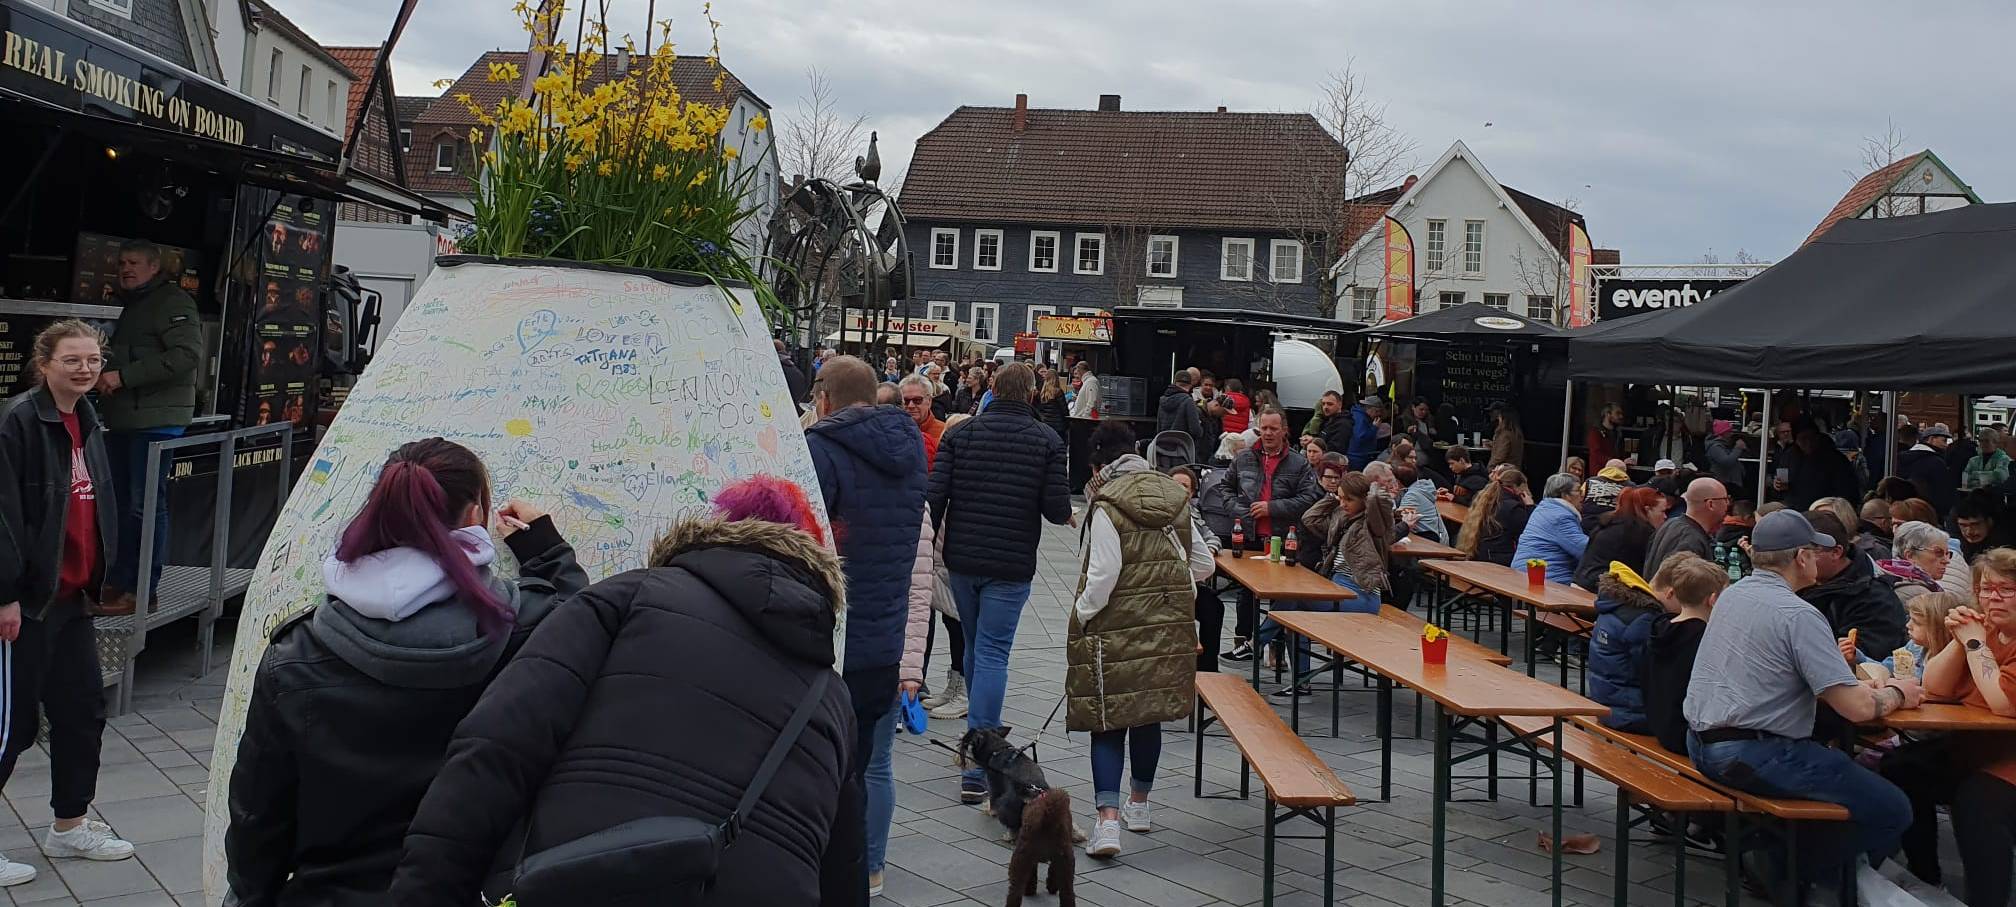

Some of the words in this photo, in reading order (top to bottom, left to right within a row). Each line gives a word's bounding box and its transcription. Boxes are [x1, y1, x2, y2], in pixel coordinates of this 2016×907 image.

[2, 31, 67, 85] REAL
[74, 59, 164, 118] SMOKING
[168, 96, 191, 128] ON
[194, 105, 244, 145] BOARD
[884, 320, 938, 332] wster
[1056, 323, 1081, 334] ASIA
[232, 454, 251, 468] LACK
[252, 449, 275, 465] HEART
